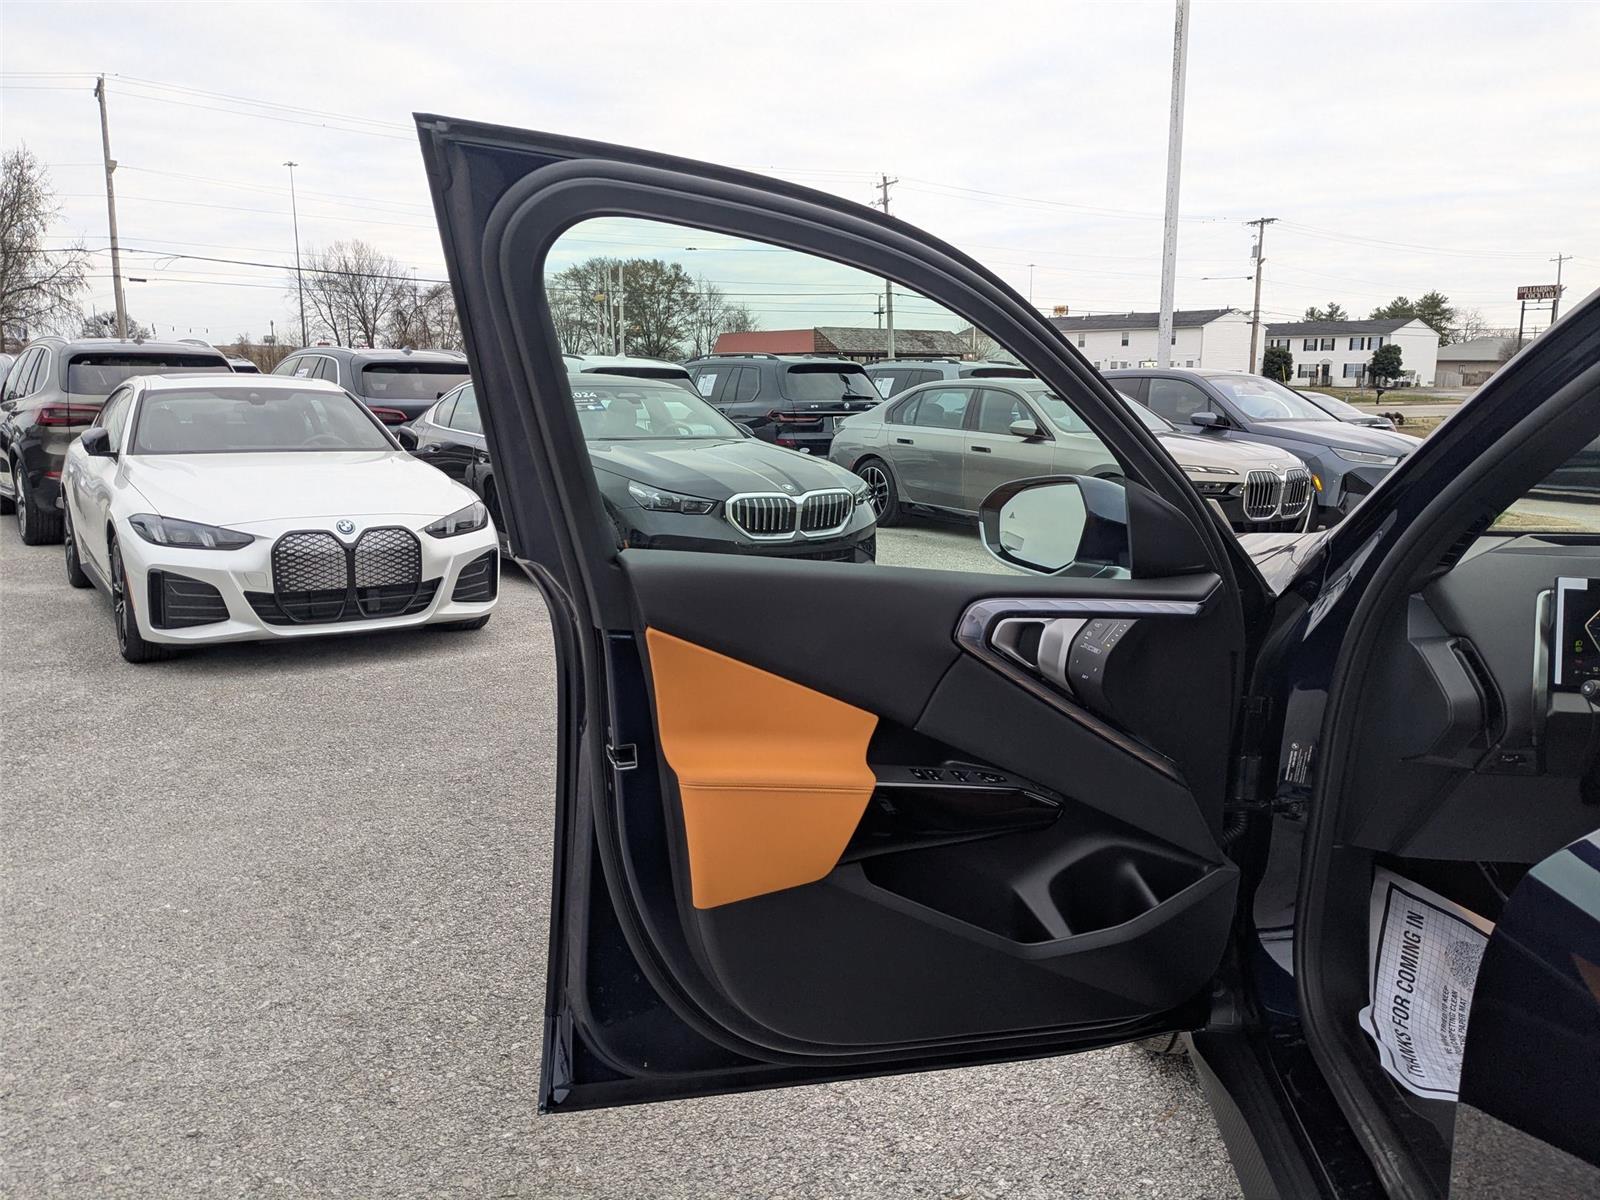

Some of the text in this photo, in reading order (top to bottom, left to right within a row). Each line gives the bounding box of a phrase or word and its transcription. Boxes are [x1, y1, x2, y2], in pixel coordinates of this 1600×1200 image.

[1525, 291, 1557, 299] COCKTAIL
[1391, 910, 1425, 1078] THANKS FOR COMING IN
[1459, 998, 1467, 1012] MAT
